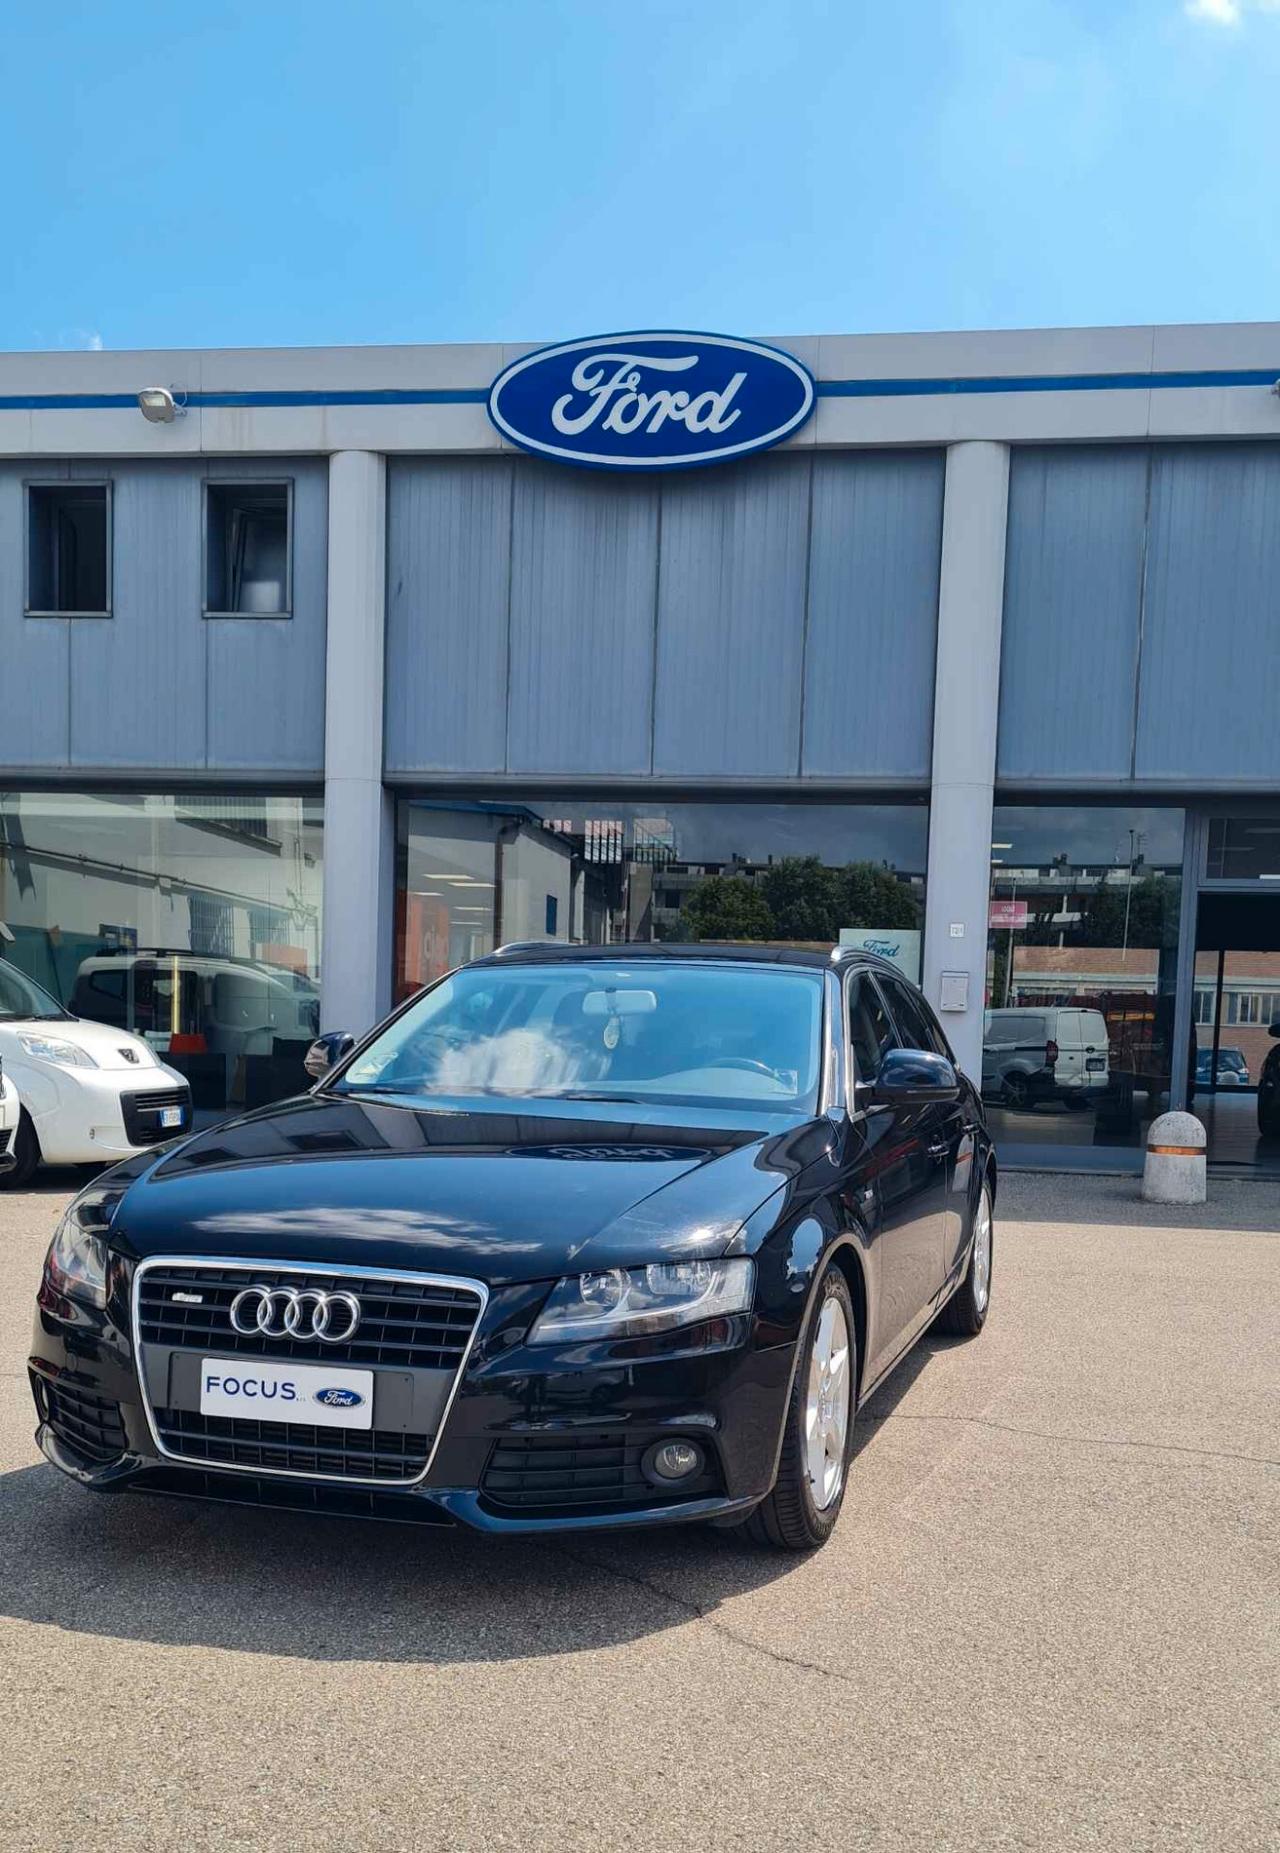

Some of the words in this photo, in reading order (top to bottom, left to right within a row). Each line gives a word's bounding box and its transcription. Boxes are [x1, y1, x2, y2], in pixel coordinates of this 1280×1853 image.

[551, 353, 748, 435] Ford
[863, 939, 900, 957] Ford
[206, 1376, 296, 1401] FOCUS
[324, 1390, 353, 1406] Ford
